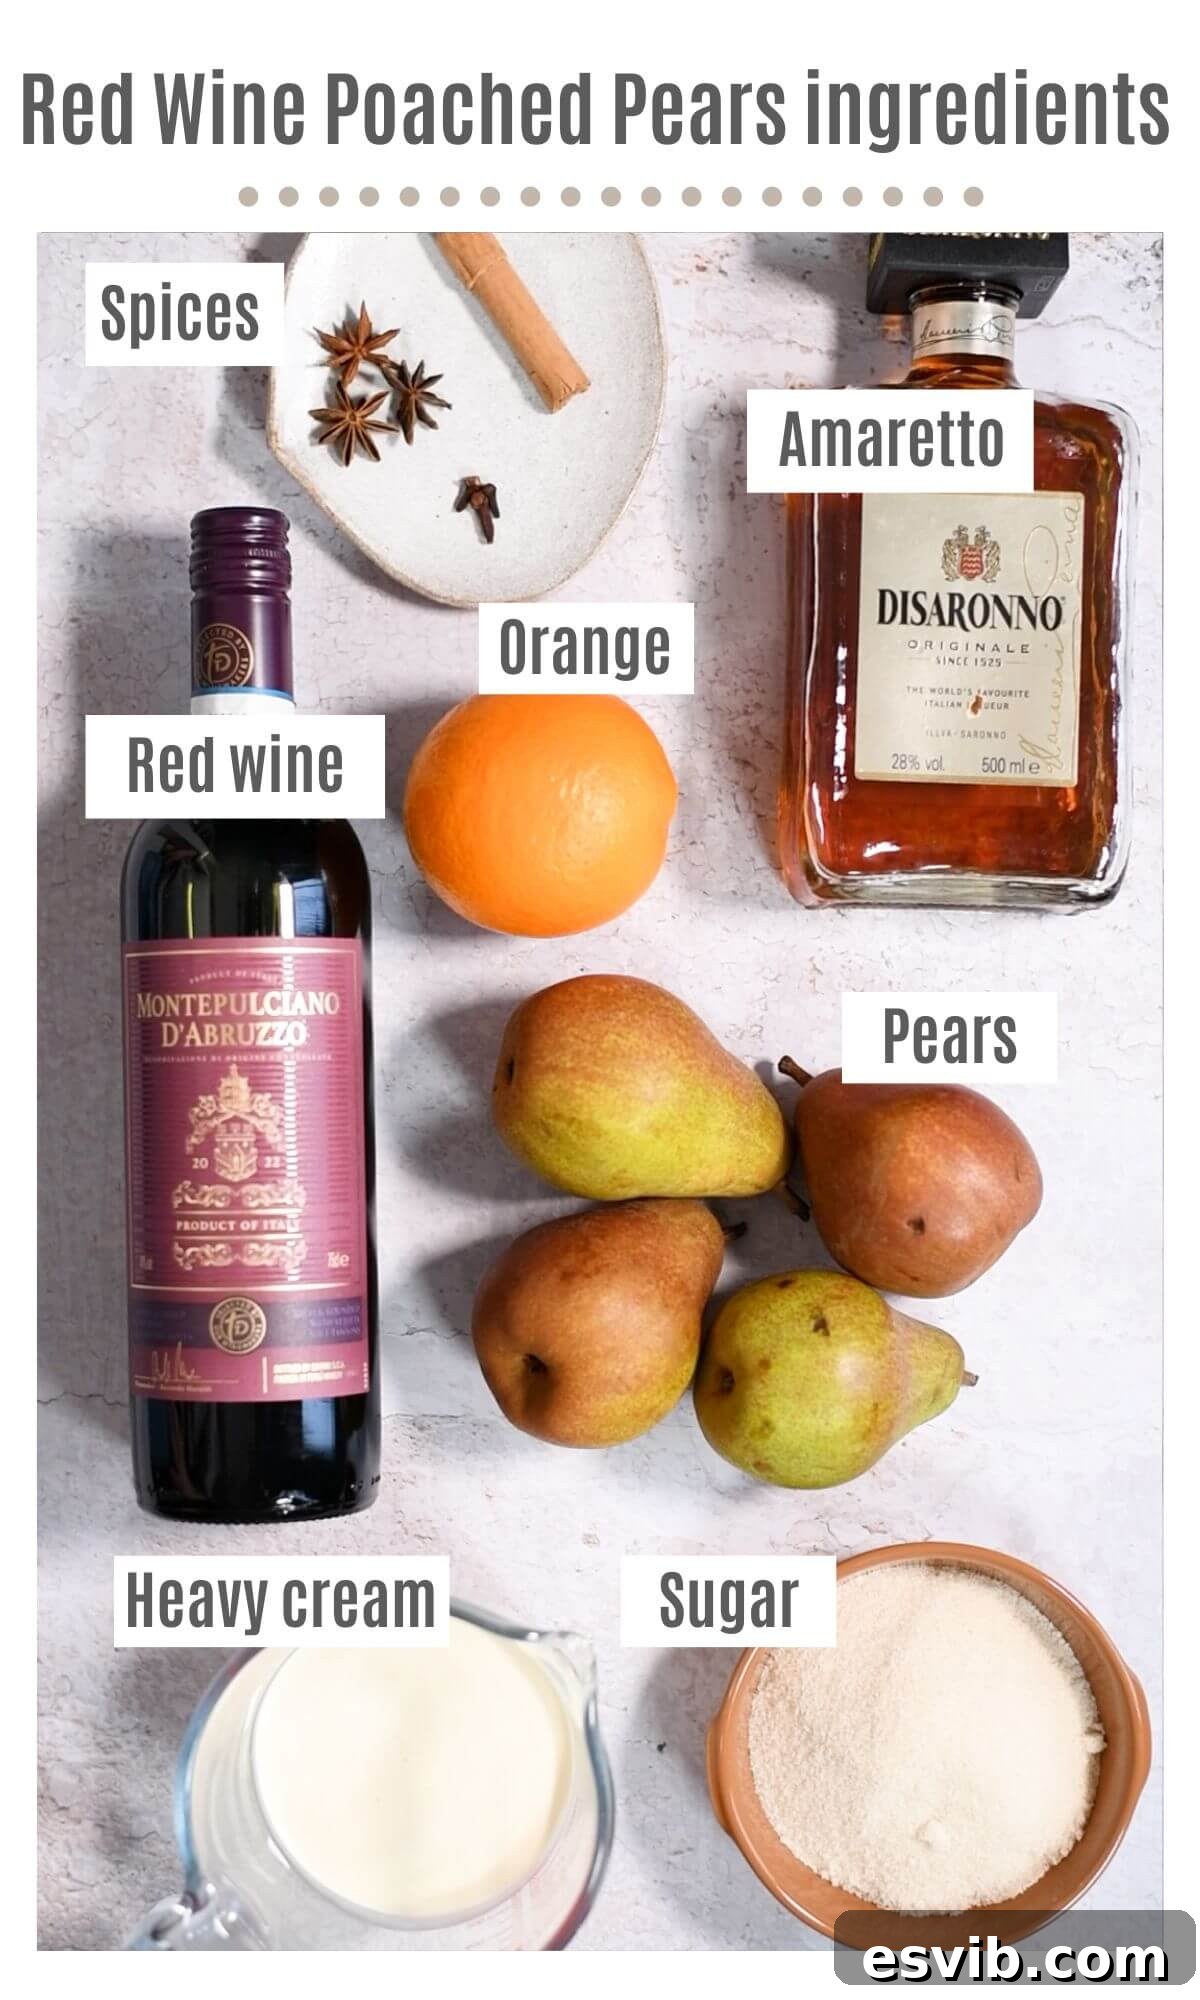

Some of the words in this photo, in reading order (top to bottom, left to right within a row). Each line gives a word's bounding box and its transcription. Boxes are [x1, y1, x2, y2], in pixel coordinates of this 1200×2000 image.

[877, 588, 1062, 632] DISARONNO
[907, 639, 1030, 654] ORIGINALE
[936, 656, 969, 666] SINCE
[906, 685, 924, 695] THE
[929, 686, 973, 697] WORLD'S
[924, 700, 962, 708] ITALIAN
[891, 753, 920, 770] 28%
[925, 755, 945, 771] vol.
[982, 757, 1006, 773] 500
[1010, 758, 1025, 774] ml
[135, 990, 340, 1018] MONTEPULCIANO
[161, 1021, 308, 1047] D'ABRUZZO
[192, 1157, 209, 1169] 20
[176, 1220, 235, 1231] PRODUCT
[239, 1220, 257, 1231] OF
